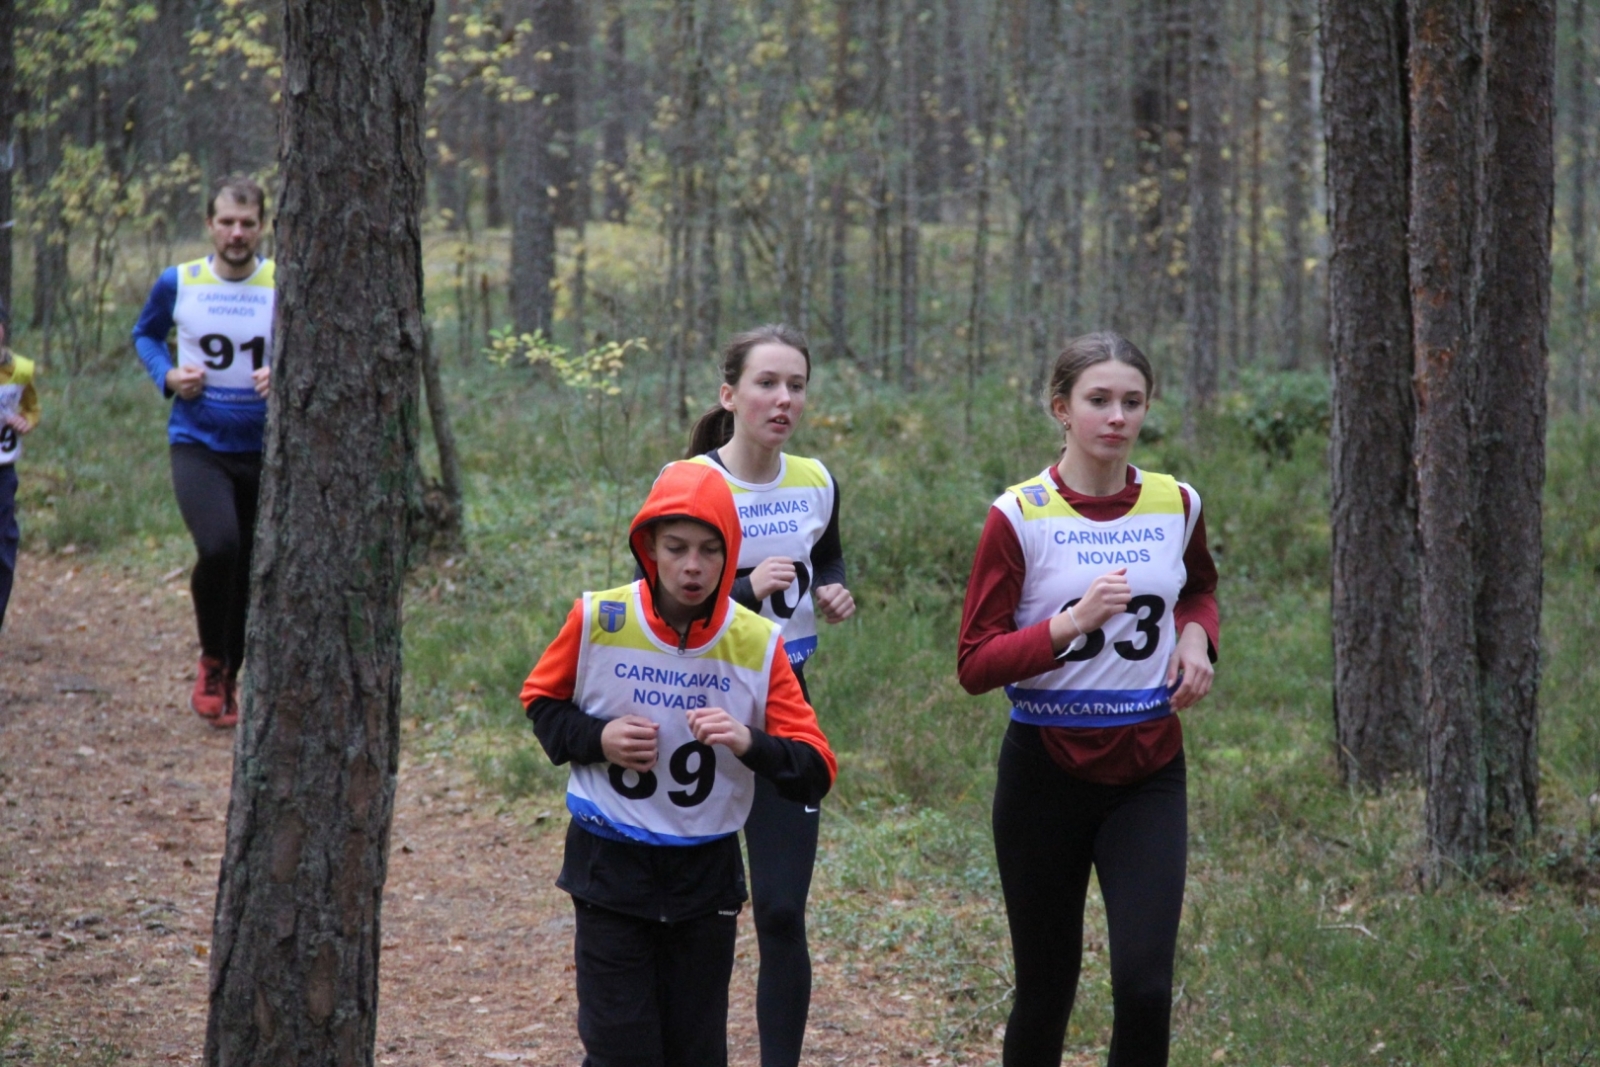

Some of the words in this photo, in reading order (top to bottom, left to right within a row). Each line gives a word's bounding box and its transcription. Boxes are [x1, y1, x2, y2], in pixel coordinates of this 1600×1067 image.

[197, 292, 267, 305] CARNIKAVAS
[207, 305, 255, 317] NOVADS
[199, 333, 265, 371] 91
[738, 500, 809, 519] RNIKAVAS
[1054, 527, 1165, 545] CARNIKAVAS
[1077, 549, 1151, 565] NOVADS
[736, 561, 810, 619] 0
[614, 663, 731, 692] CARNIKAVAS
[633, 688, 707, 710] NOVADS
